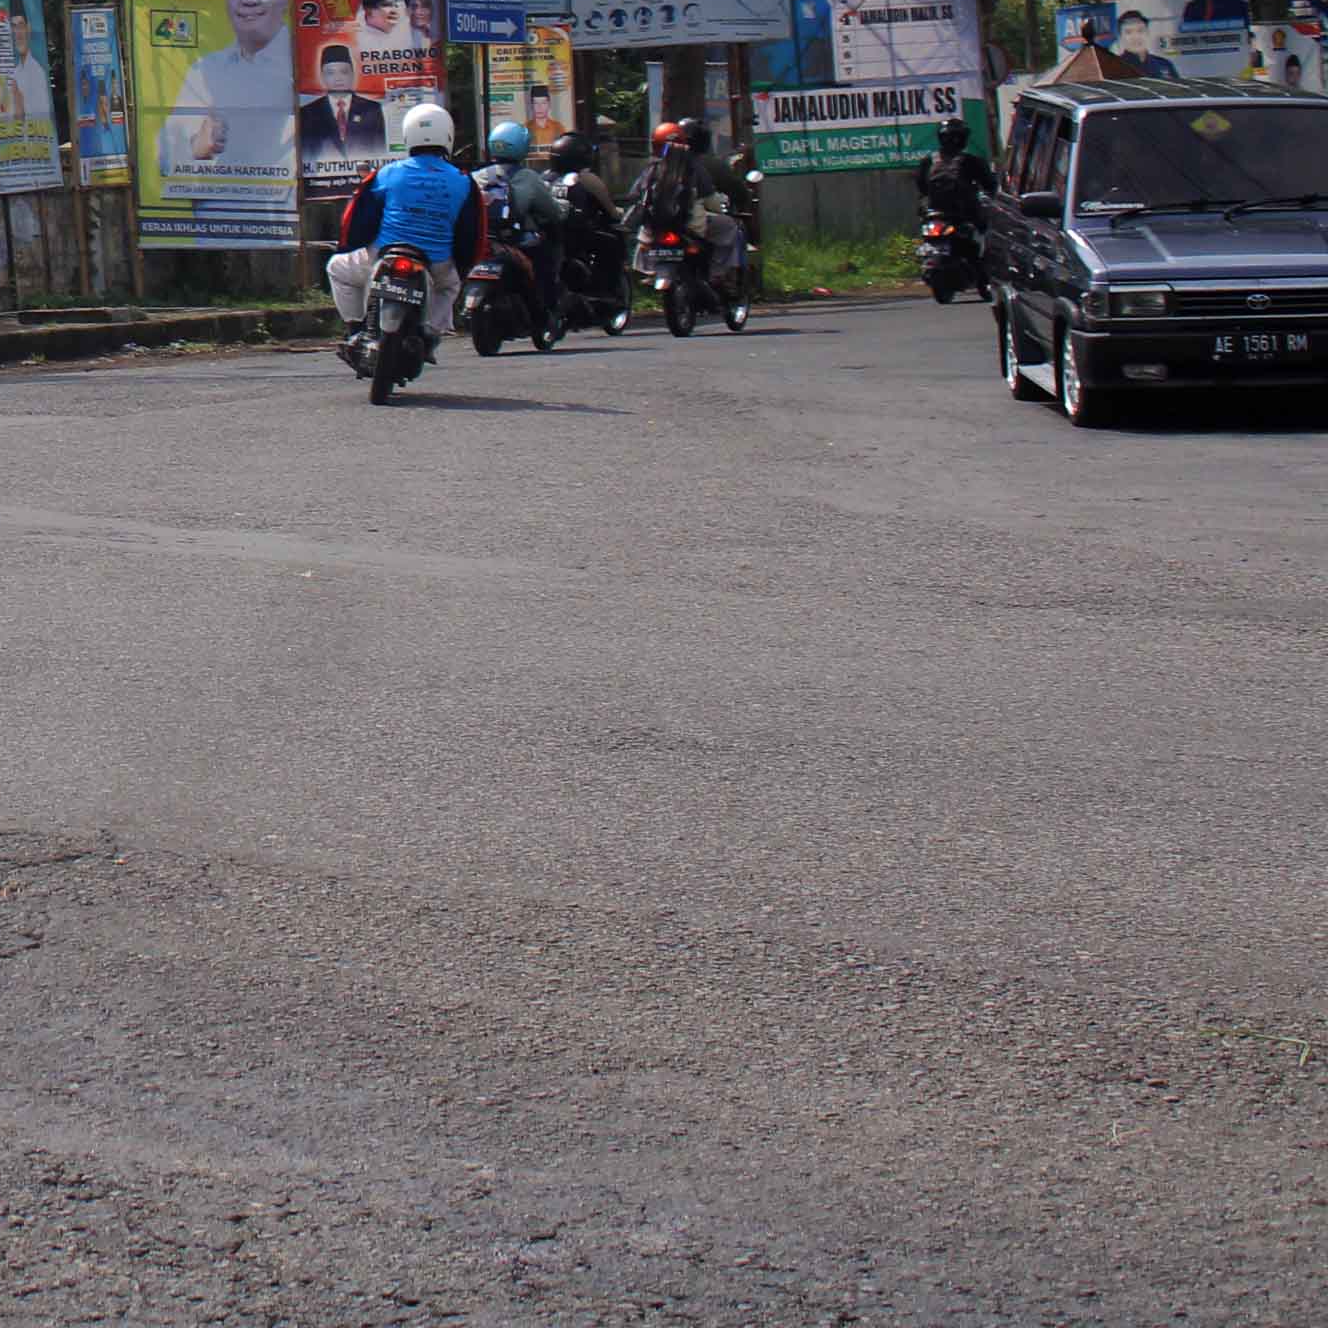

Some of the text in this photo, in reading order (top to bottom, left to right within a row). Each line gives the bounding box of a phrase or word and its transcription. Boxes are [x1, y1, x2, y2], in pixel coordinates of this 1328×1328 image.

[298, 1, 321, 28] 2
[456, 12, 488, 33] 500m
[360, 47, 440, 62] PRABOWO
[361, 62, 424, 75] GIBRAN
[773, 92, 869, 123] JAMALUDIN
[934, 86, 957, 113] SS
[827, 134, 898, 152] MAGETAN
[234, 165, 290, 177] HARTARTO
[303, 160, 314, 173] H.
[143, 222, 173, 233] KERJA
[210, 223, 241, 234] UNTUK
[243, 224, 294, 236] INDONESIA
[1215, 336, 1233, 353] AE
[1242, 334, 1279, 352] 1561
